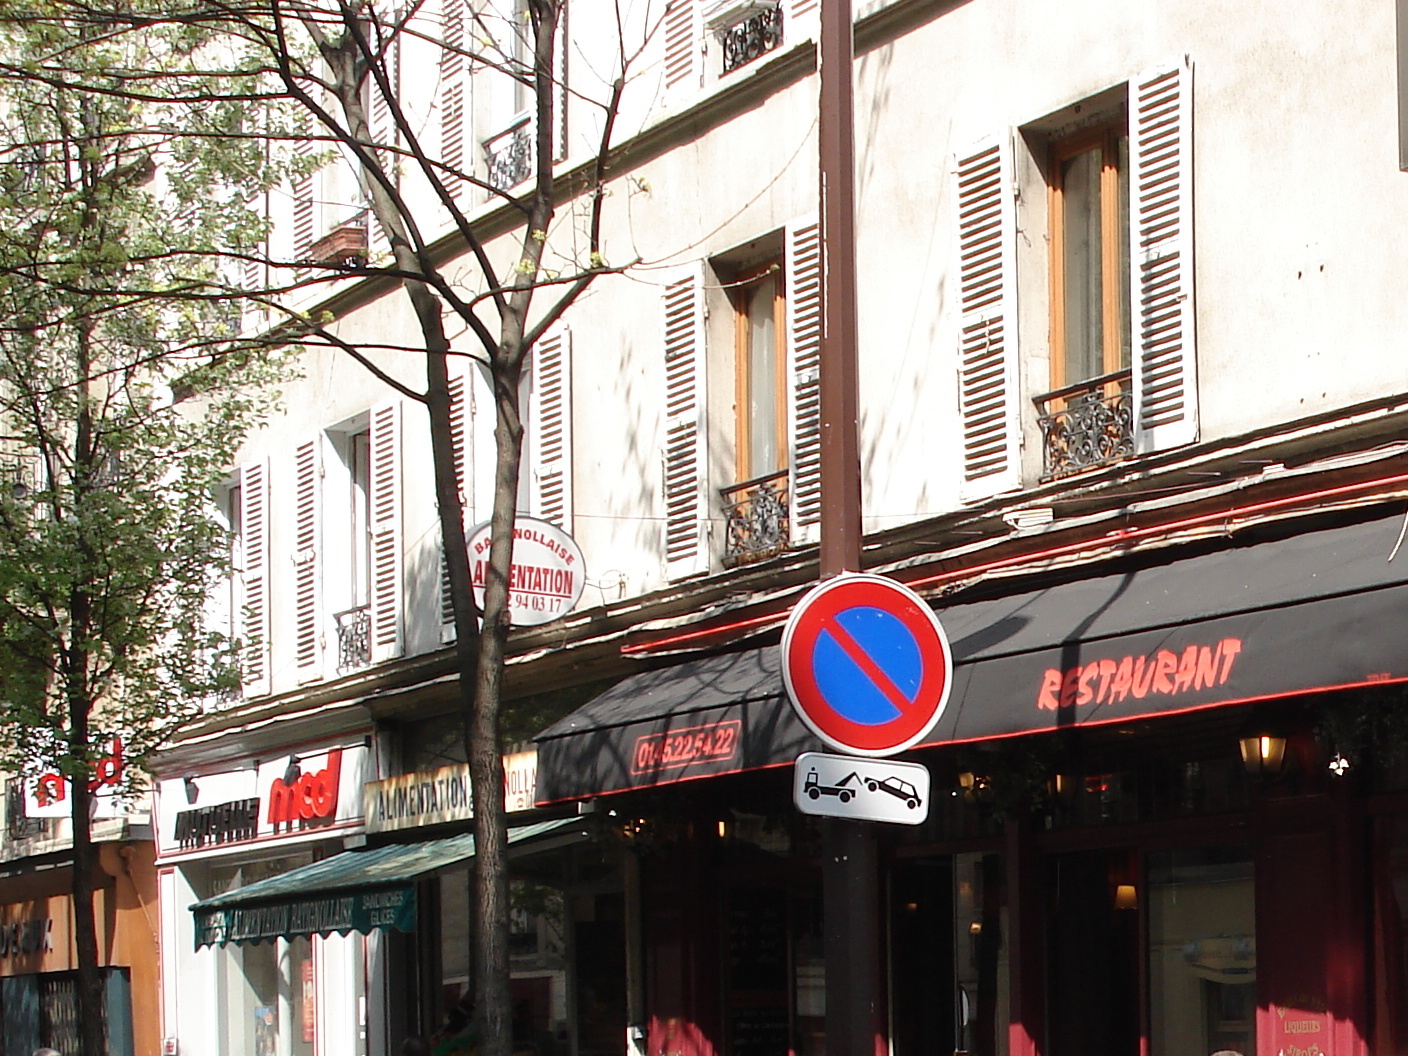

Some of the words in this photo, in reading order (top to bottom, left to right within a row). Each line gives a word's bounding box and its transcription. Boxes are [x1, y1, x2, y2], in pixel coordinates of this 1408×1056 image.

[474, 528, 575, 566] BANOLLAISE
[474, 560, 573, 595] AENTATION
[515, 593, 528, 610] 94
[532, 596, 545, 612] 03
[549, 598, 562, 613] 17
[1037, 637, 1242, 711] RESTAURANT
[379, 774, 467, 822] ALIMENTATION
[1284, 1020, 1321, 1034] LIQUEURS
